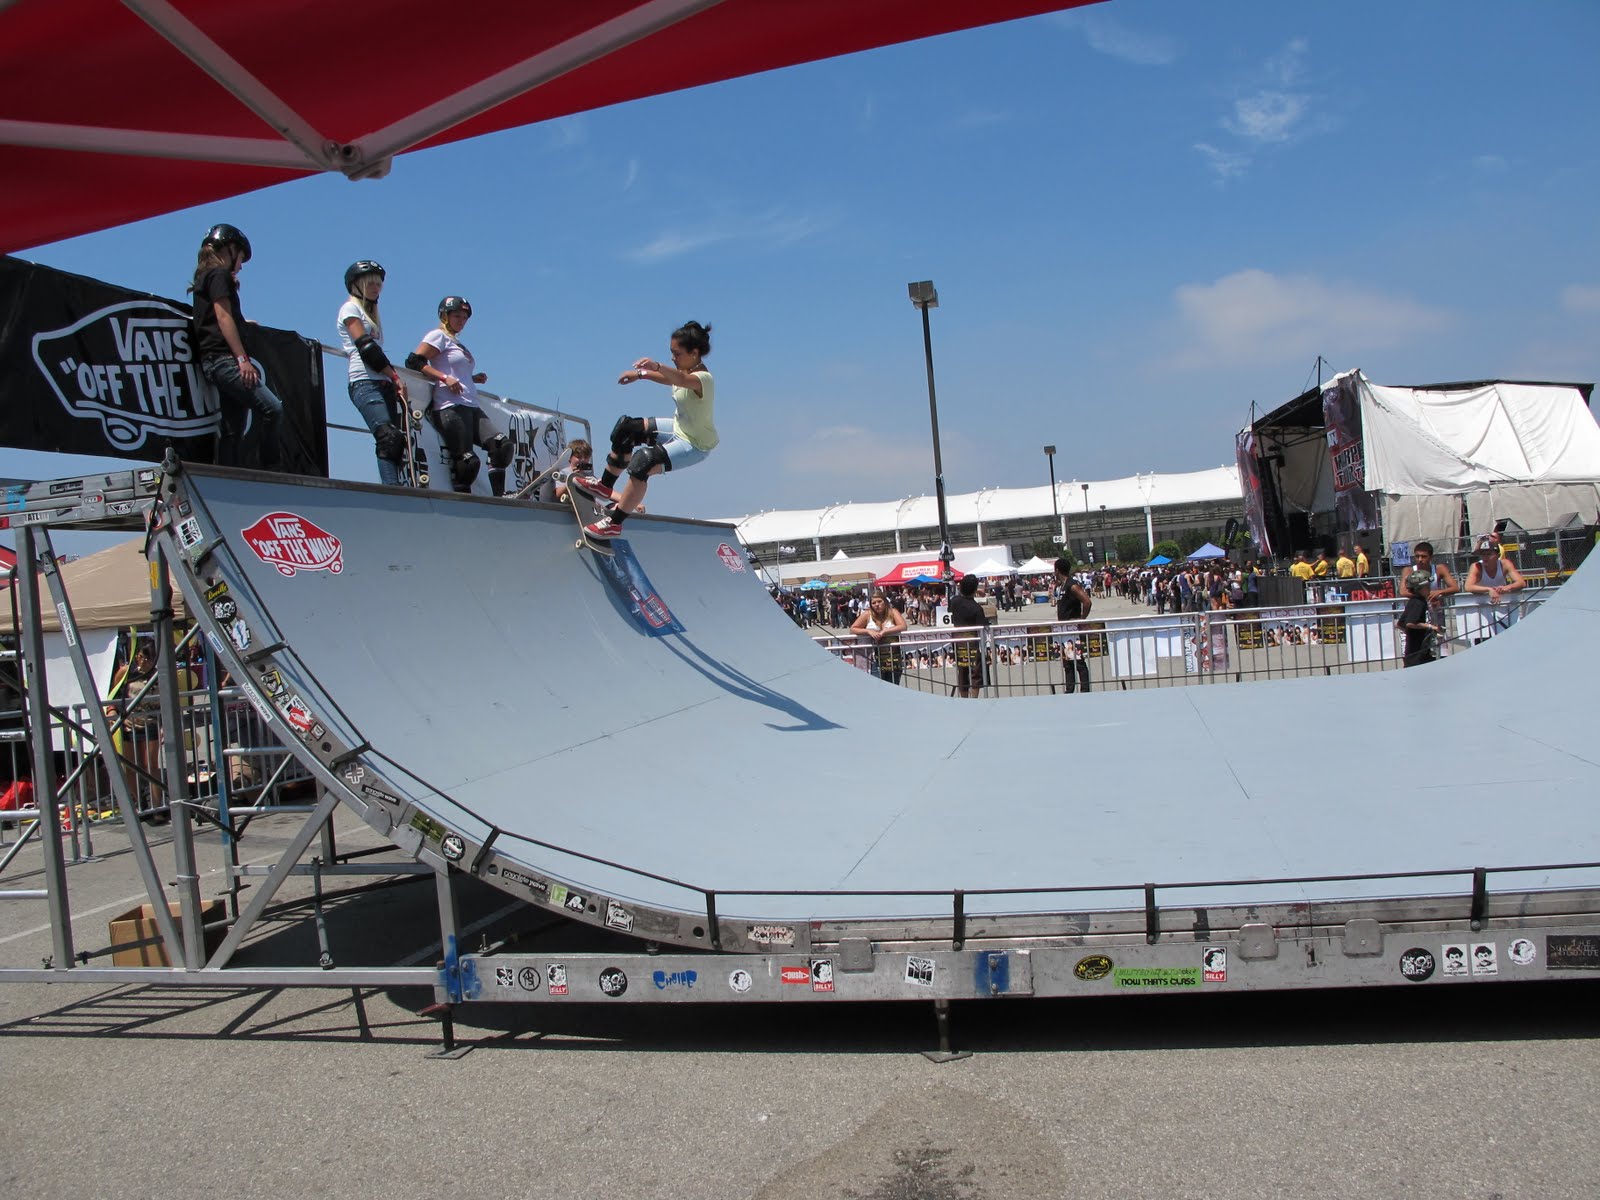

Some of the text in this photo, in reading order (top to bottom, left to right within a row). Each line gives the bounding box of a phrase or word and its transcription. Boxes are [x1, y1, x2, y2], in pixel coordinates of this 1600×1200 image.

[109, 317, 192, 362] VANS
[125, 363, 187, 418] THE
[266, 518, 306, 538] VANS
[281, 539, 314, 564] THE
